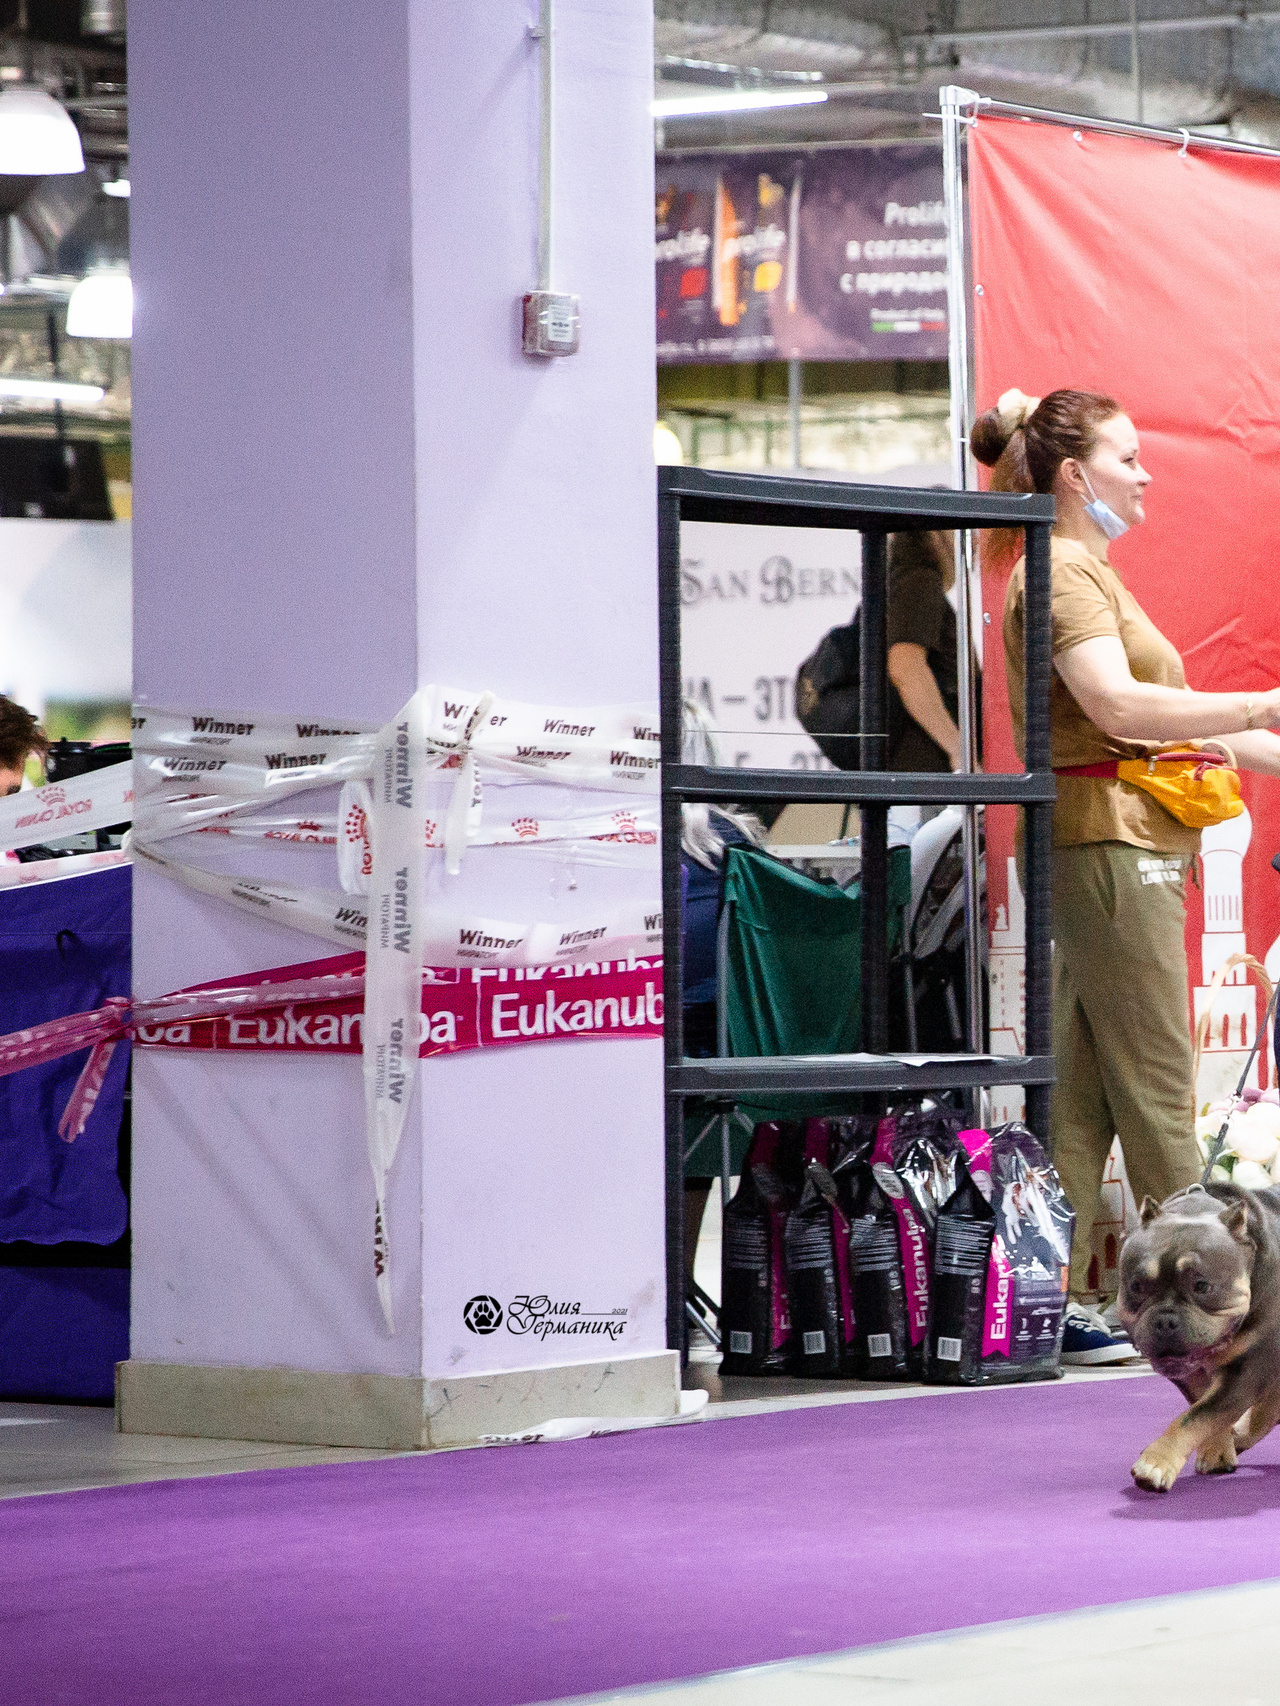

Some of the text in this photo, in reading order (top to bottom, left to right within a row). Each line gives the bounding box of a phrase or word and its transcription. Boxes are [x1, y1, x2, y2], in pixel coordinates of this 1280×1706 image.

[191, 716, 255, 736] Winner
[543, 719, 596, 737] Winner
[164, 757, 227, 772] Winner
[265, 752, 327, 770] Winner
[459, 929, 525, 949] Winner
[560, 926, 607, 946] Winner
